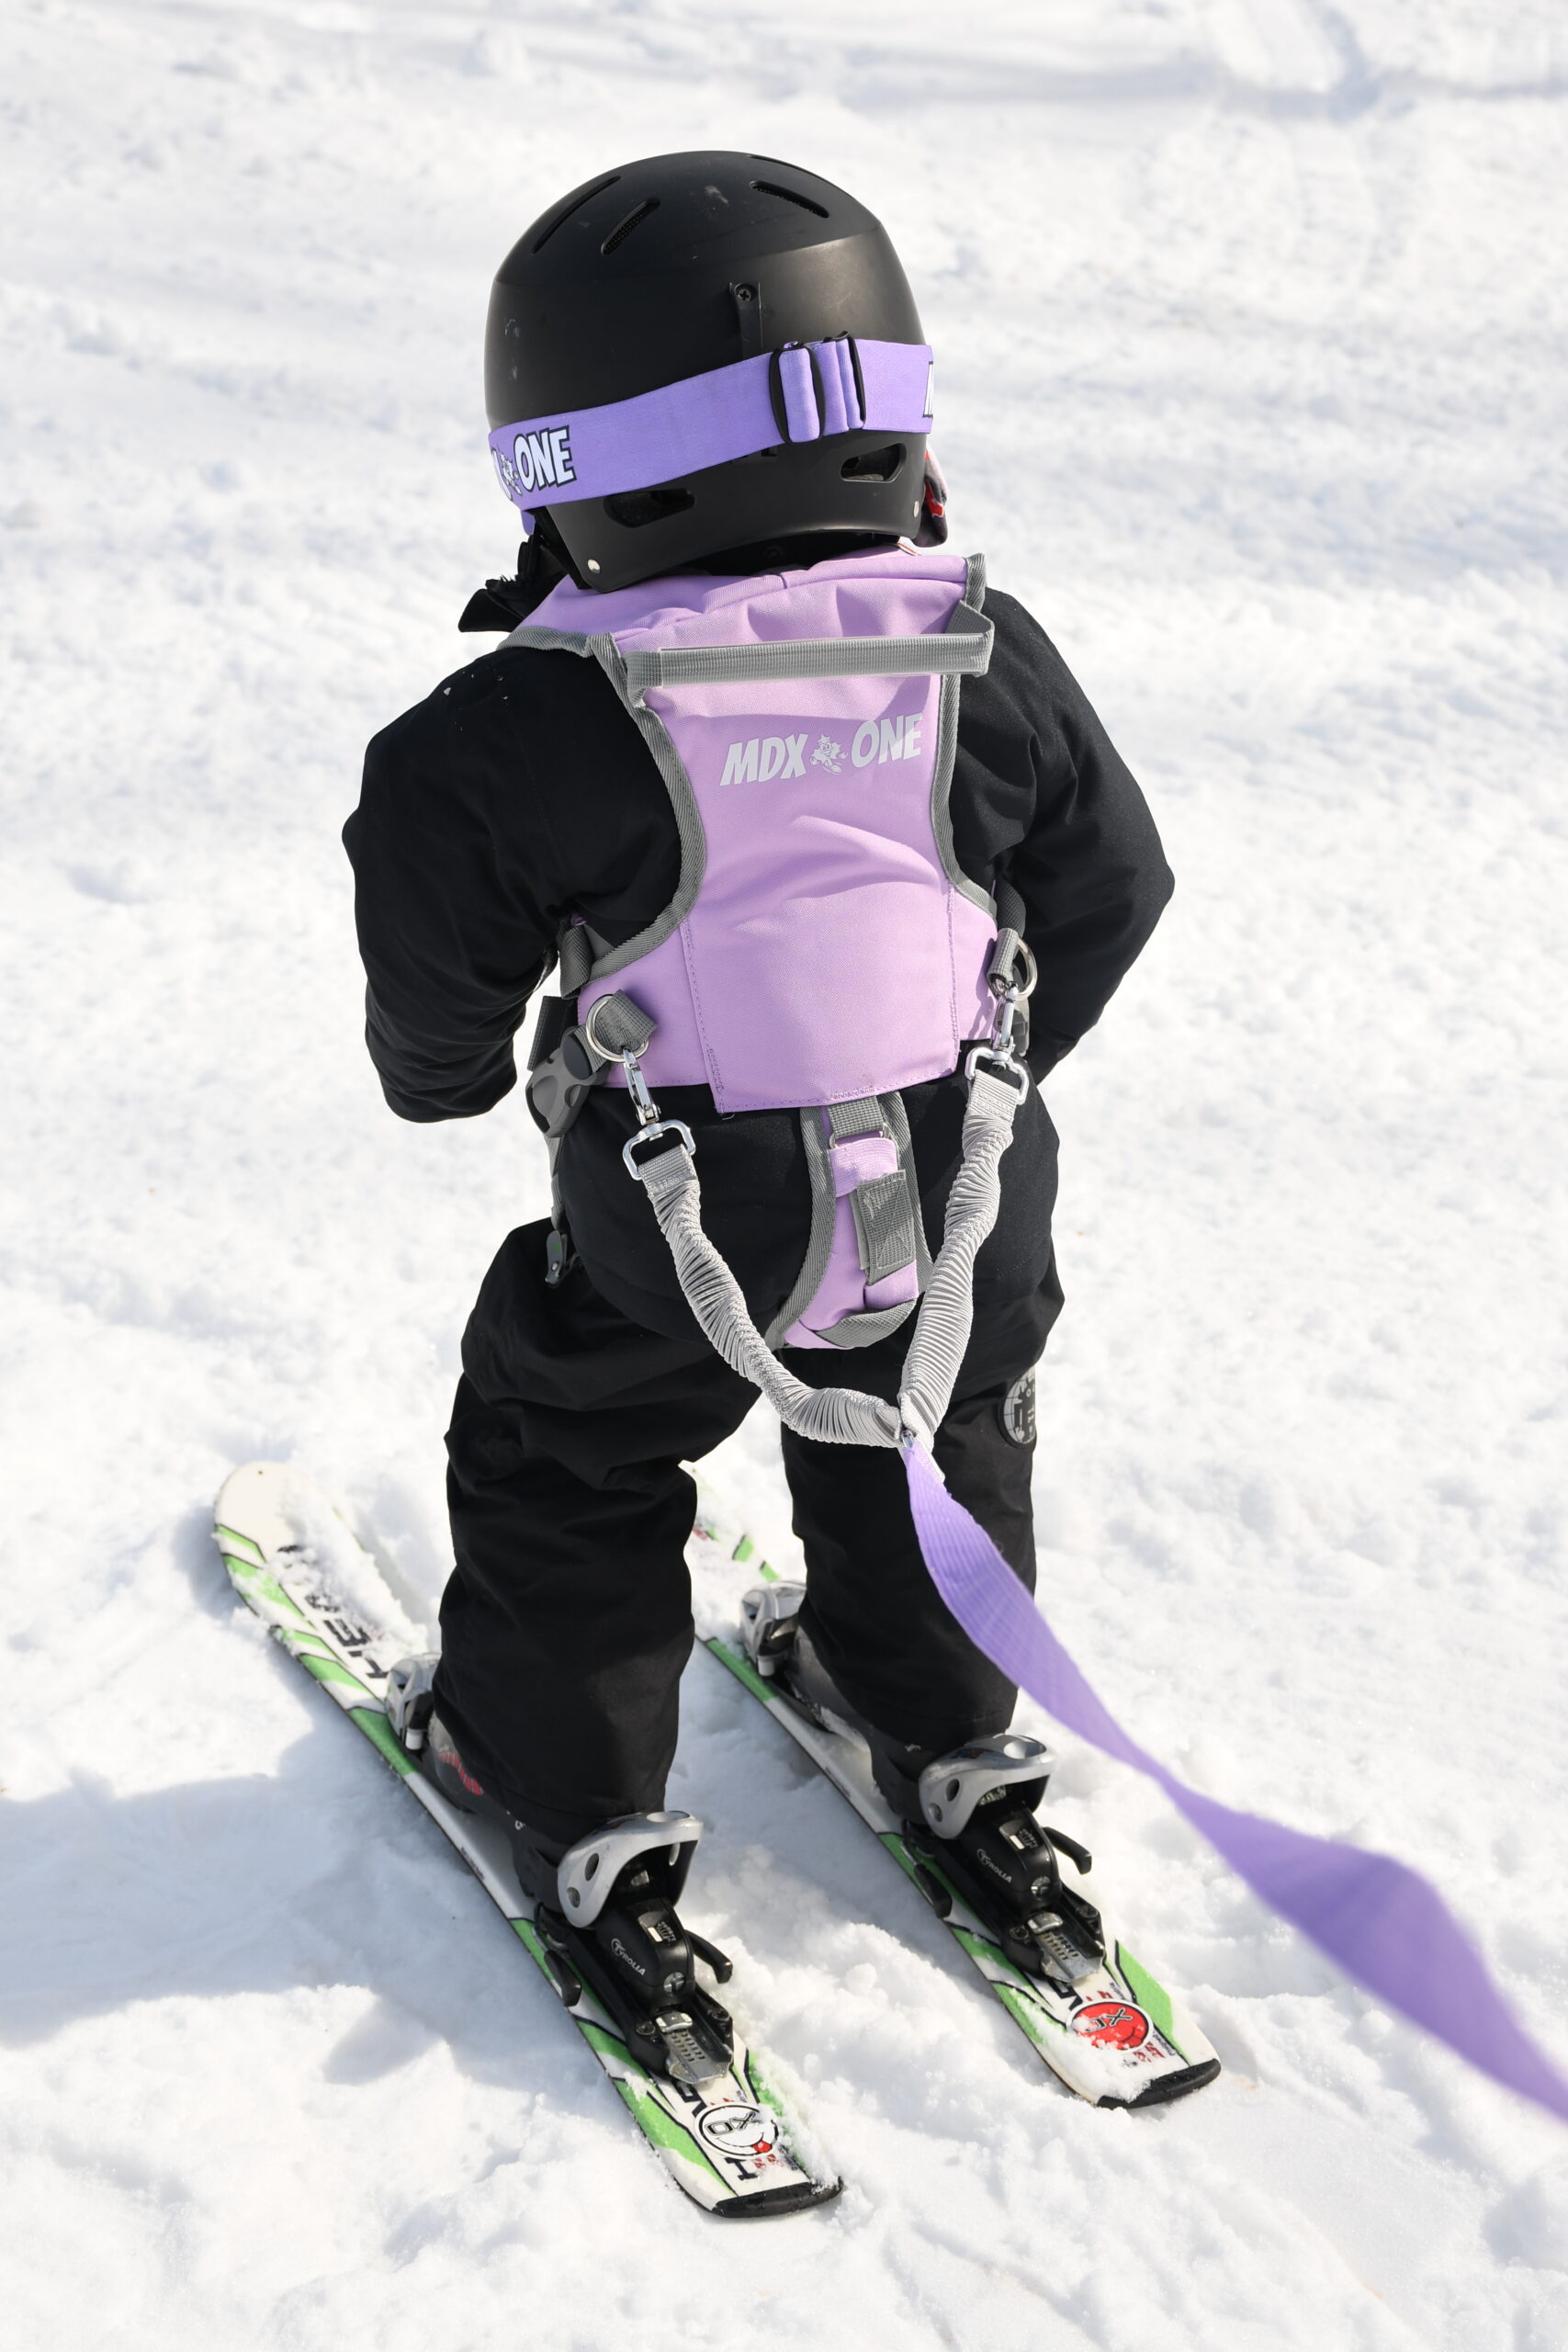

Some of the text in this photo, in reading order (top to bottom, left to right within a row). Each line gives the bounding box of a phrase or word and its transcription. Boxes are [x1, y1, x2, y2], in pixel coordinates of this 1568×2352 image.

[513, 425, 577, 492] ONE
[720, 713, 922, 786] MDX ONE
